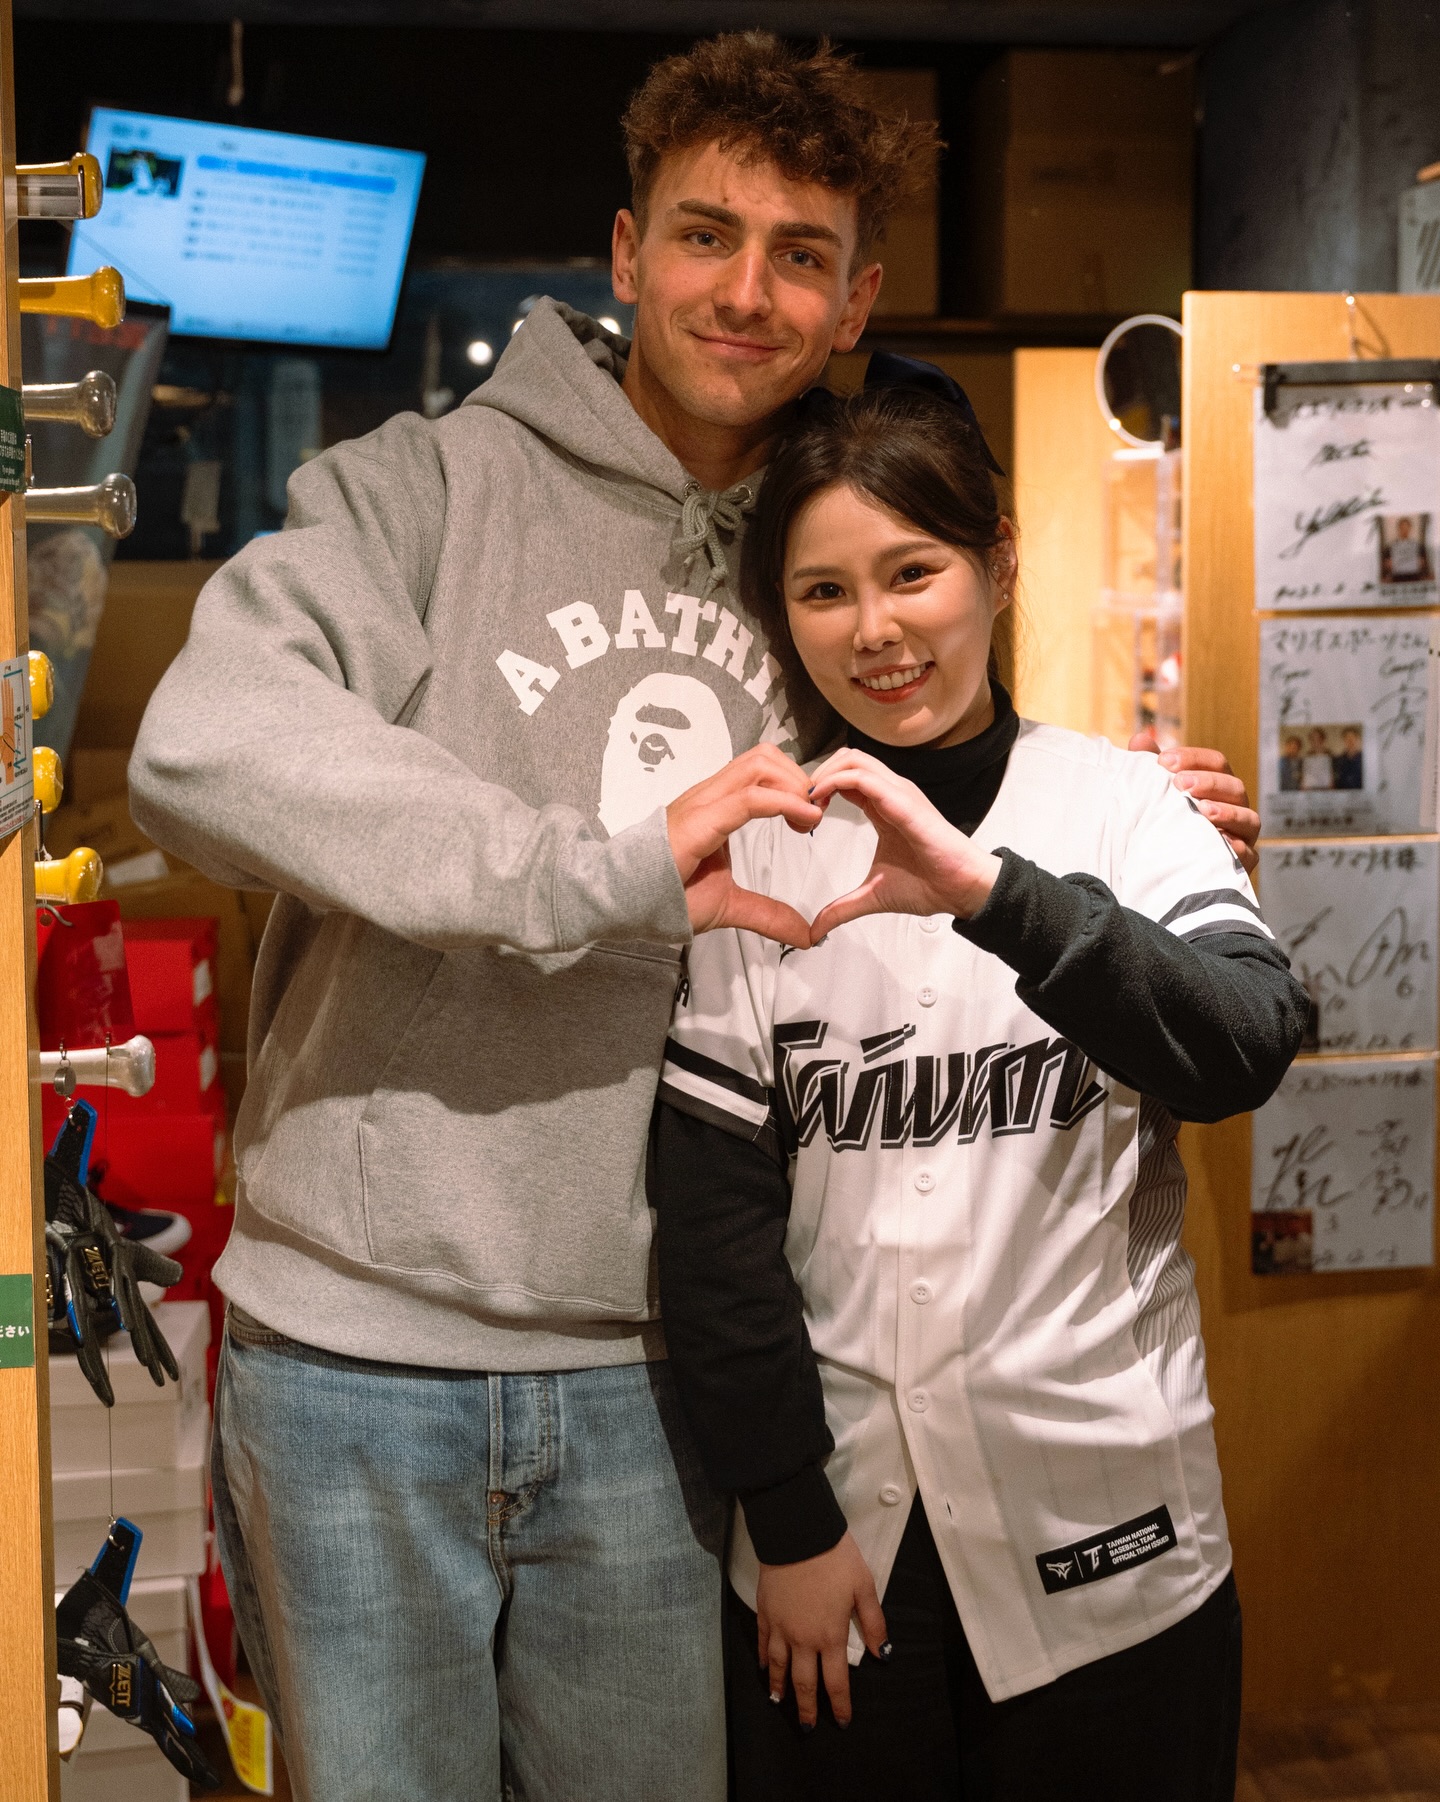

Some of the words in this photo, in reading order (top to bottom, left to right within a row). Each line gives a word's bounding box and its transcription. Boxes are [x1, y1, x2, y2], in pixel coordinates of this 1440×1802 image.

[495, 648, 562, 717] A
[546, 589, 799, 755] BATHIN
[1106, 1534, 1132, 1549] TAIWAN
[1130, 1522, 1160, 1541] NATIONAL
[1109, 1540, 1141, 1557] BASEBALL
[1139, 1532, 1157, 1545] TEAM
[1112, 1550, 1138, 1565] OFFICIAL
[1136, 1543, 1152, 1555] TEAM
[1150, 1534, 1170, 1549] ISSUED
[117, 1663, 132, 1707] ZETT
